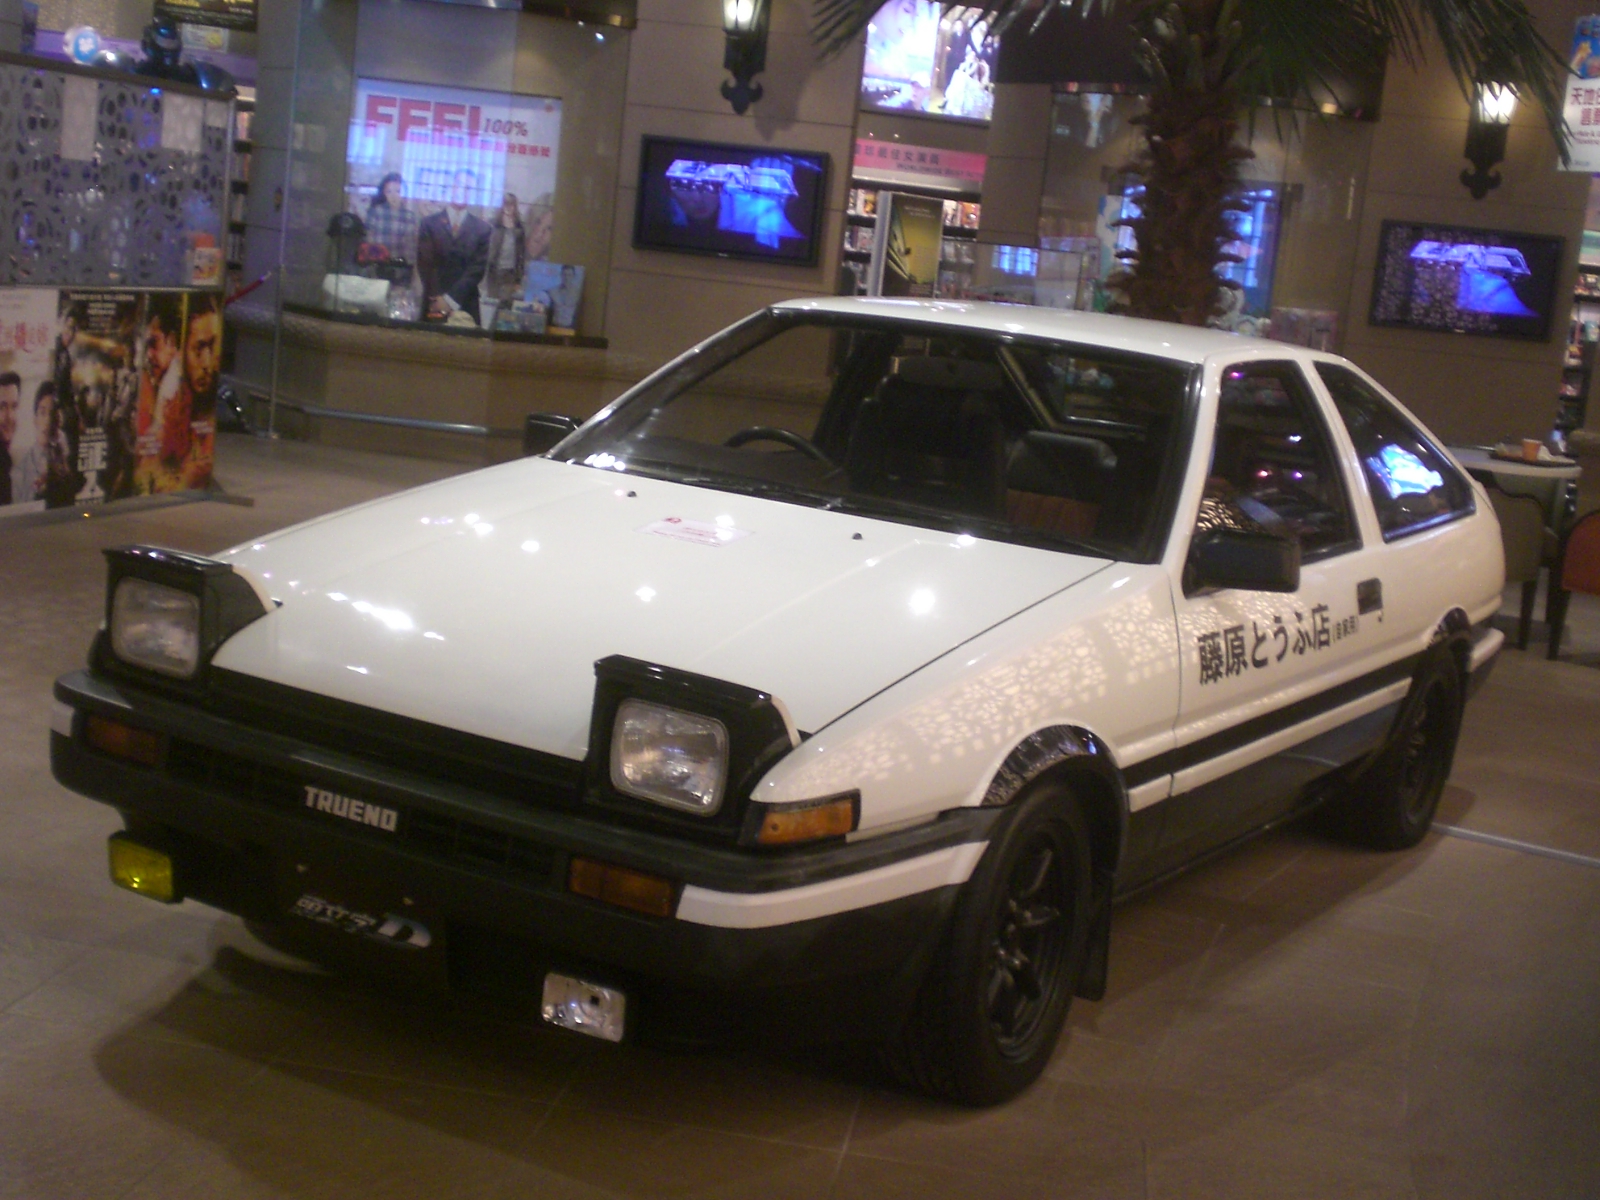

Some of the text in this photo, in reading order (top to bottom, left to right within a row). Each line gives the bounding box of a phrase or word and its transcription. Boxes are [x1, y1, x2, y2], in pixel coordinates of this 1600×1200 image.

[483, 117, 529, 137] 100%
[1198, 603, 1331, 686] 藤原とうふ店
[304, 785, 399, 832] TRUENO
